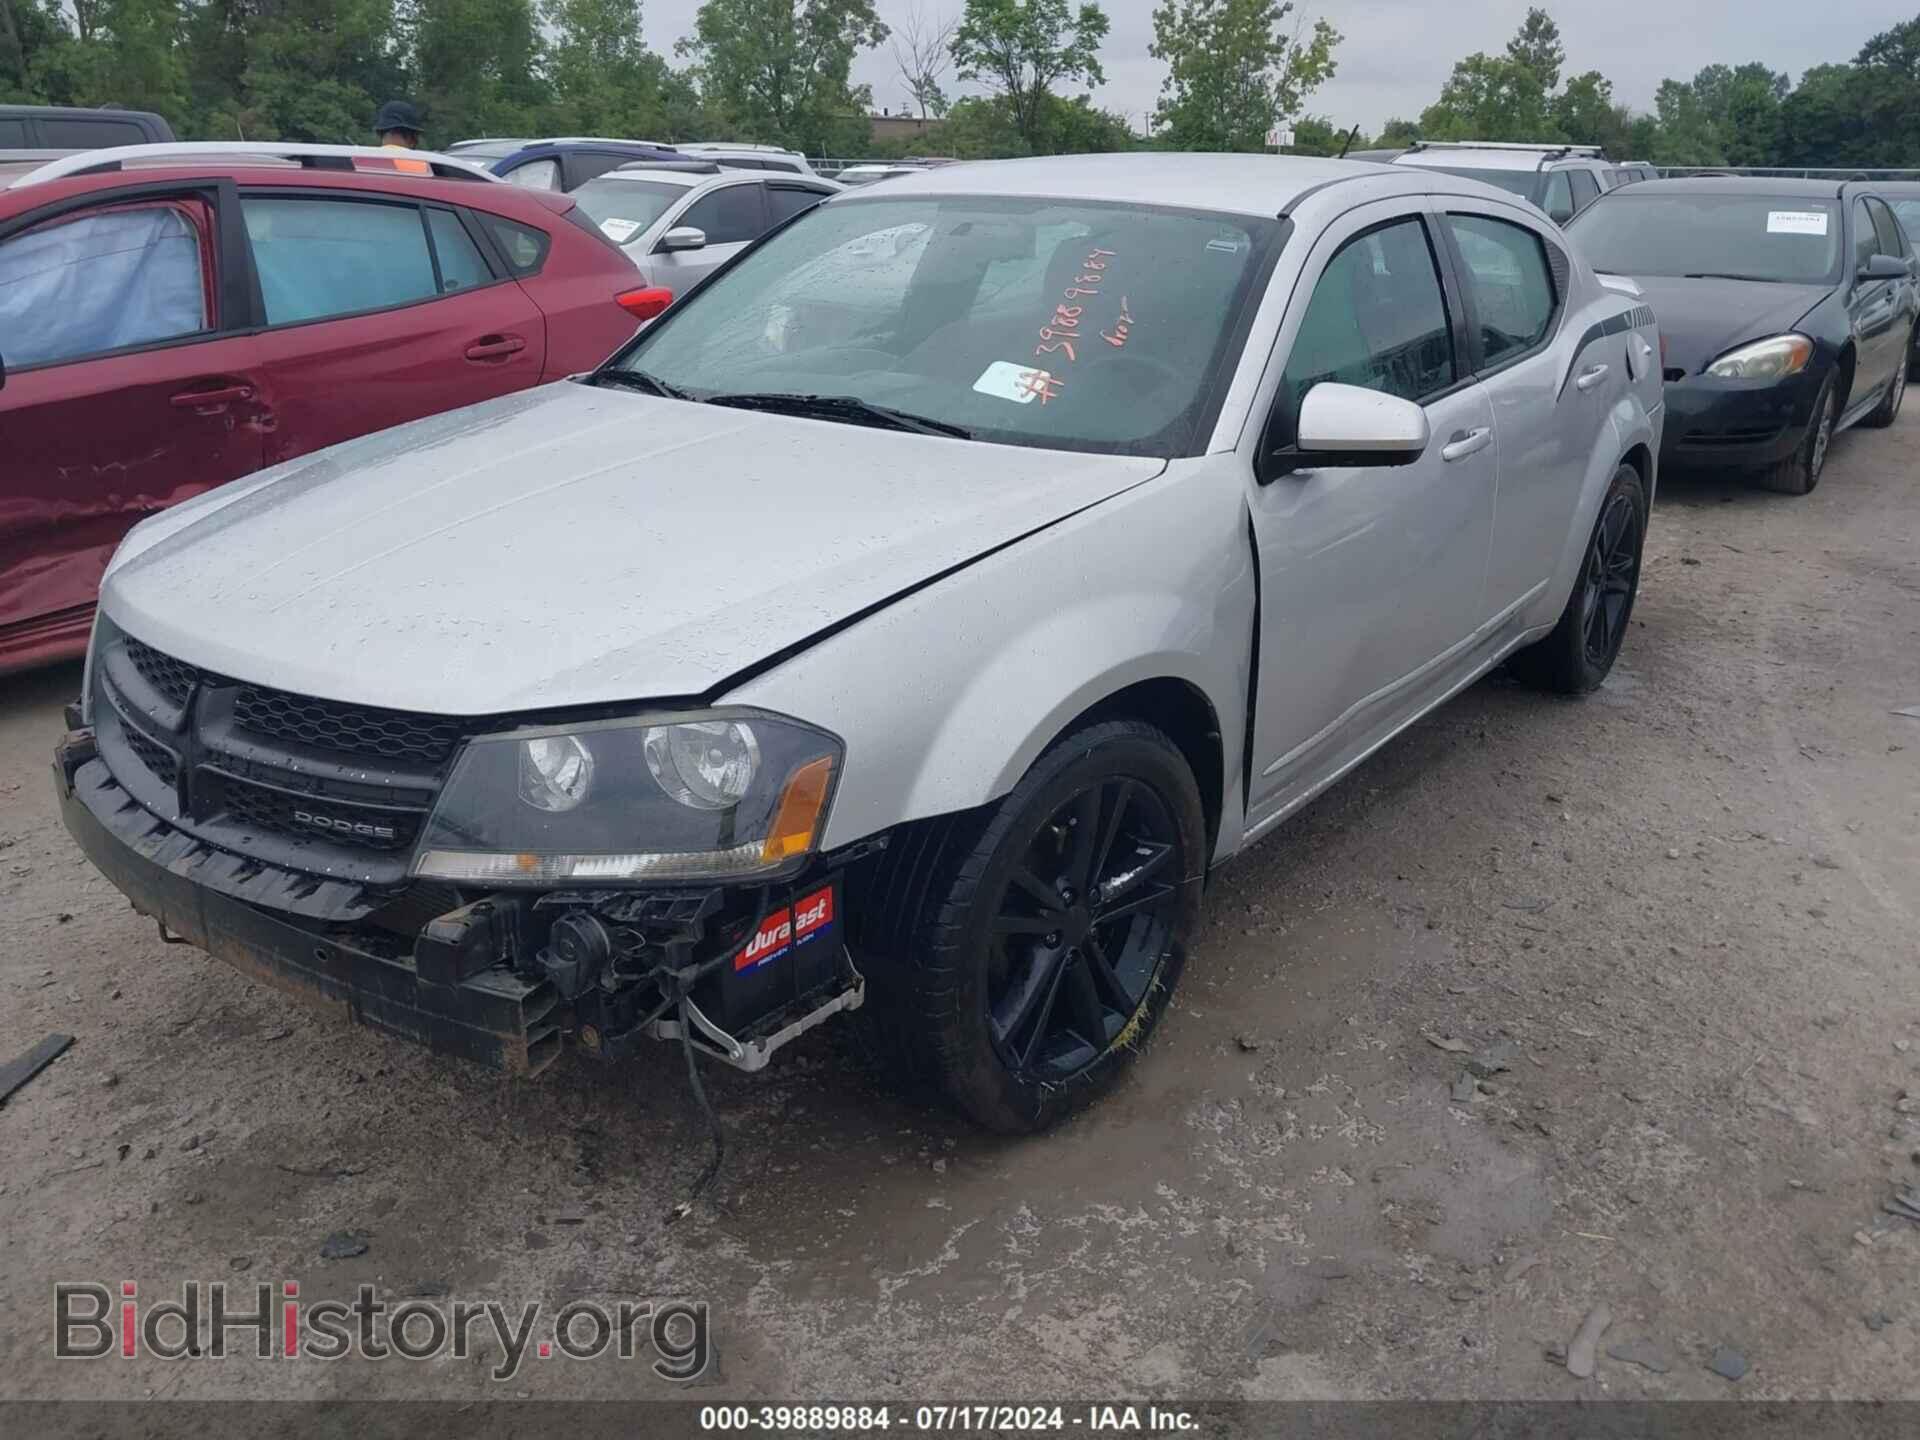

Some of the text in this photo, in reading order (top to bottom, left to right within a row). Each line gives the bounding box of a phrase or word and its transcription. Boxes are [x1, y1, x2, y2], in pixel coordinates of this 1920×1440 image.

[1035, 248, 1117, 361] 39889884
[294, 810, 393, 838] DODGE
[744, 898, 828, 959] duraast
